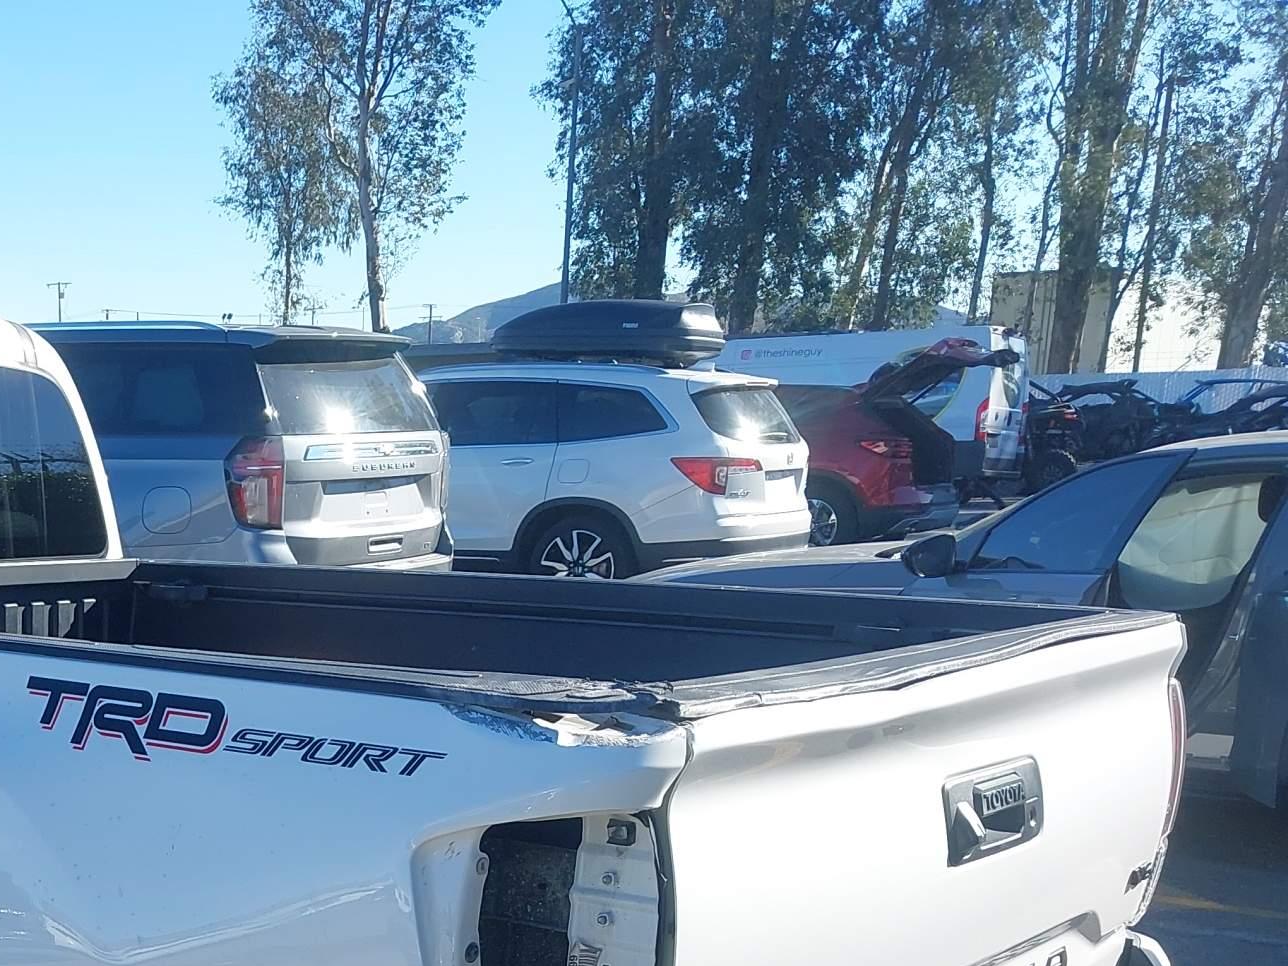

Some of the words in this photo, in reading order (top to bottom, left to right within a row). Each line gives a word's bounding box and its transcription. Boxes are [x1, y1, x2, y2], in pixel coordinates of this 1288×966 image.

[755, 346, 823, 358] @theshineguy
[26, 675, 229, 763] TRD
[223, 728, 448, 777] SPORT
[982, 783, 1026, 812] TOYOTA
